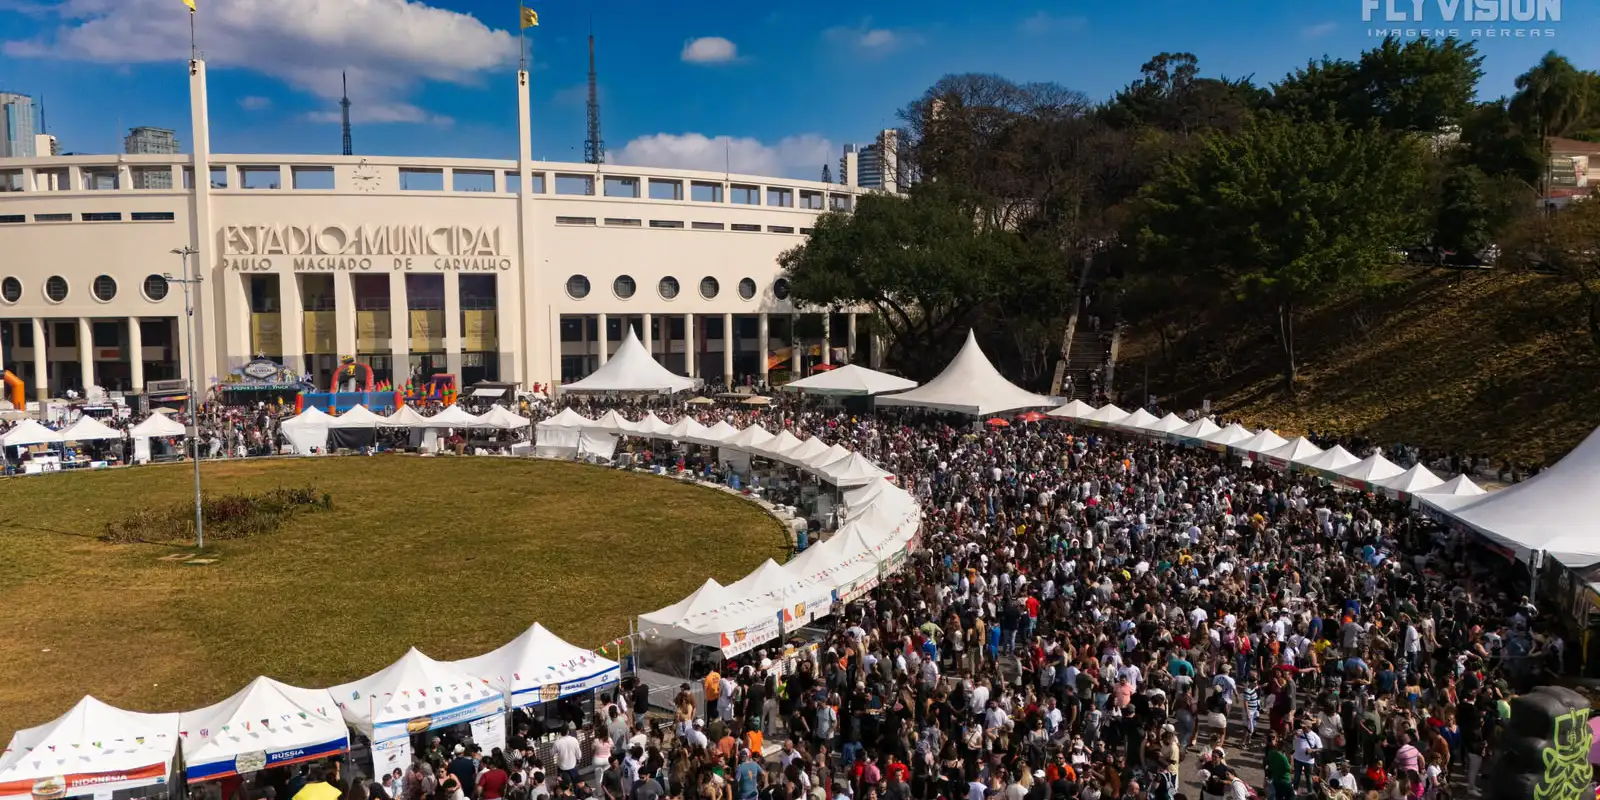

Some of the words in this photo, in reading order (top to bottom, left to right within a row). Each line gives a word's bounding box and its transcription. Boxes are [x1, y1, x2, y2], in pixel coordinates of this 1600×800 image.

[361, 222, 506, 255] MUNICIPAL
[293, 257, 372, 271] MACHADO
[393, 257, 413, 271] DE
[434, 257, 511, 271] CARVALHO
[565, 682, 586, 691] ISRAEL
[435, 708, 477, 723] ARGENTINA
[271, 749, 305, 761] RUSSIA
[71, 774, 128, 788] INDONESIA
